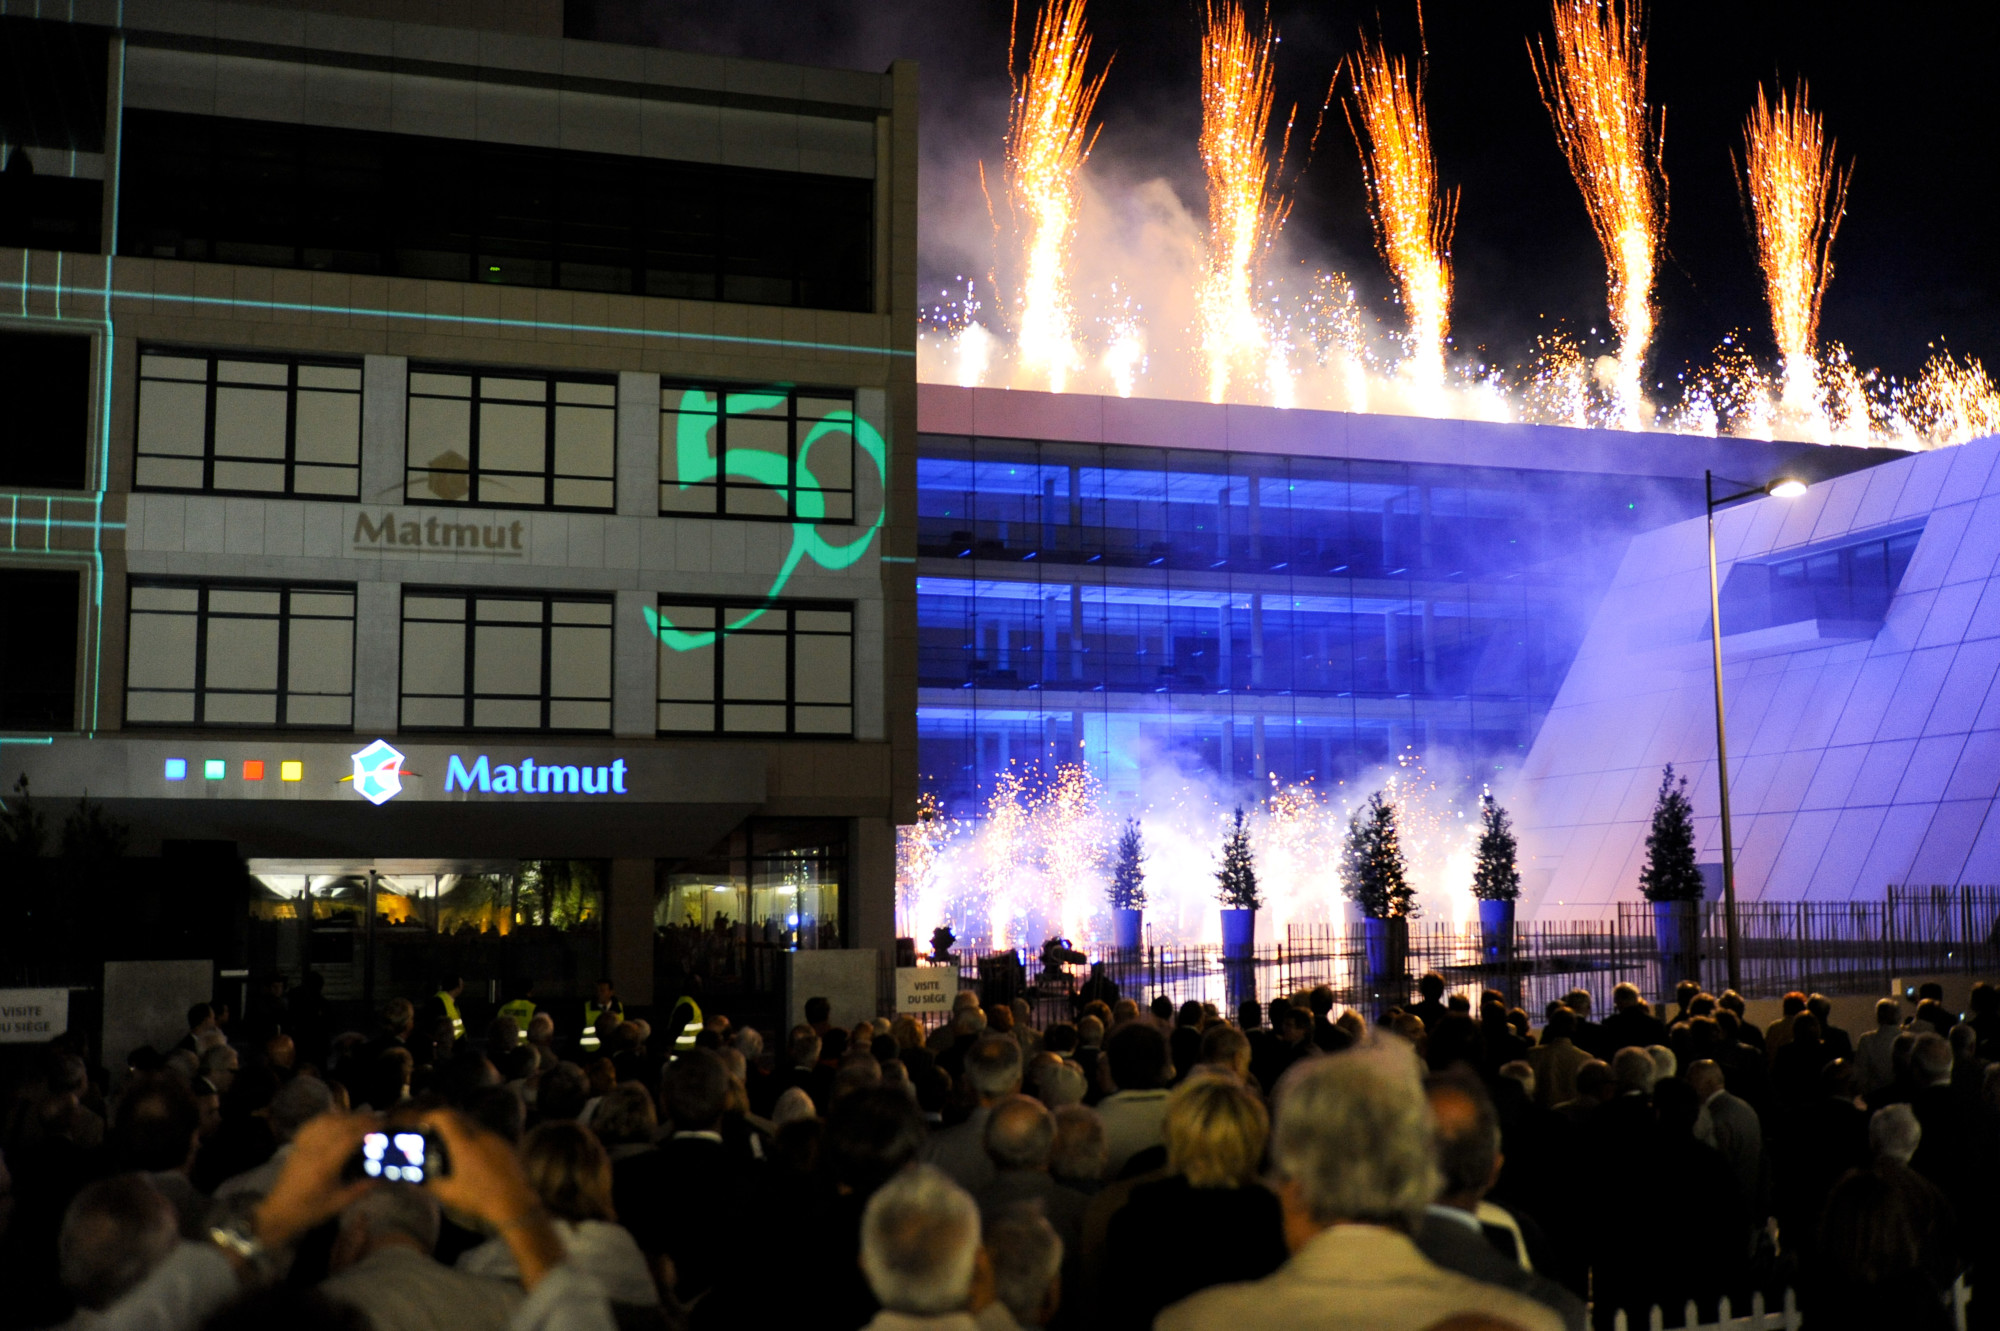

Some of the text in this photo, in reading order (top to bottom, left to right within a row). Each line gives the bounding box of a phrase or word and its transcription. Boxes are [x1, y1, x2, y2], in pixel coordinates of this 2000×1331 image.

[353, 511, 523, 550] Matmut
[444, 754, 628, 795] Matmut
[914, 981, 939, 991] VISITE
[908, 995, 920, 1005] DU
[2, 1006, 41, 1017] VISITE
